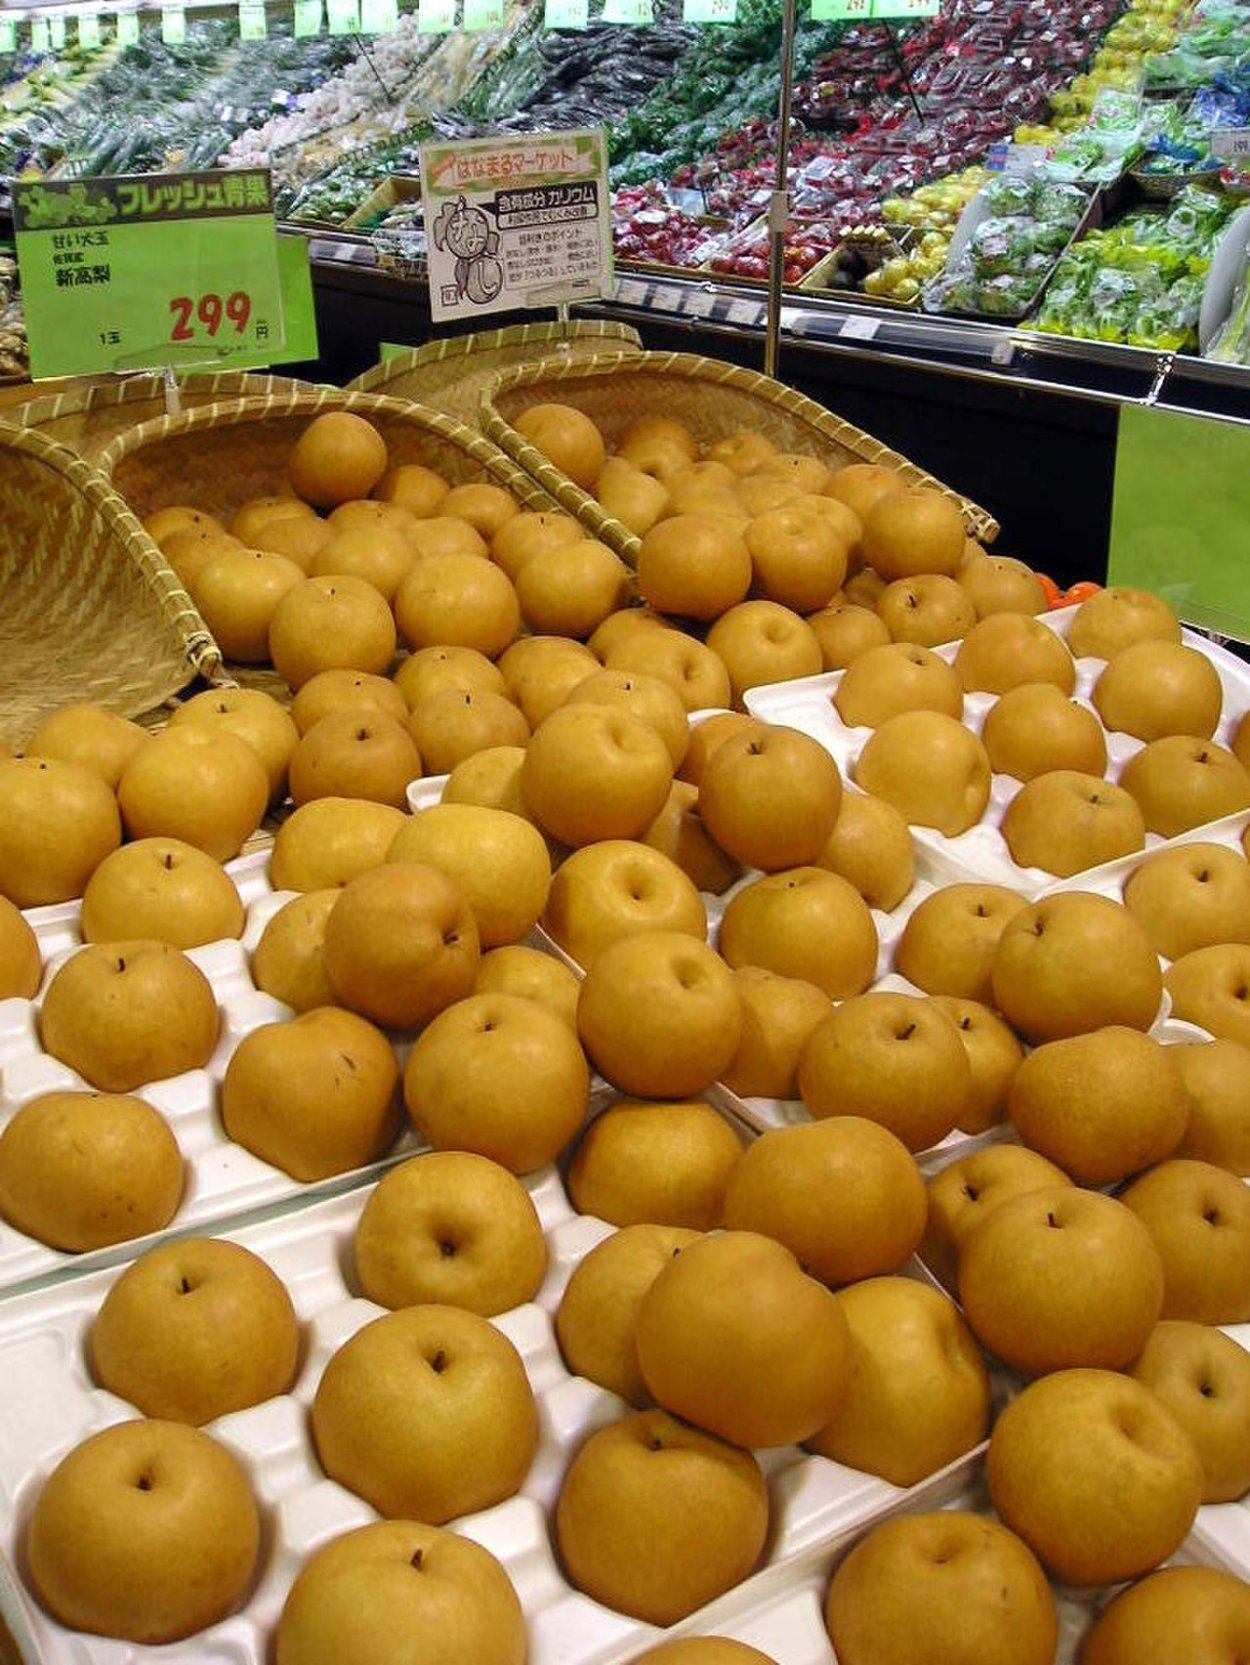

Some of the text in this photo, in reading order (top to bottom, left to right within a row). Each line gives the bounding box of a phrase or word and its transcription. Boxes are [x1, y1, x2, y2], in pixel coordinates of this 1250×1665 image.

[457, 148, 573, 180] はなまるマーケット
[116, 175, 267, 214] フレッシュ青果
[547, 186, 596, 206] カリウム
[53, 230, 110, 250] 甘い大玉
[55, 263, 111, 287] 新高梨
[169, 291, 251, 341] 299
